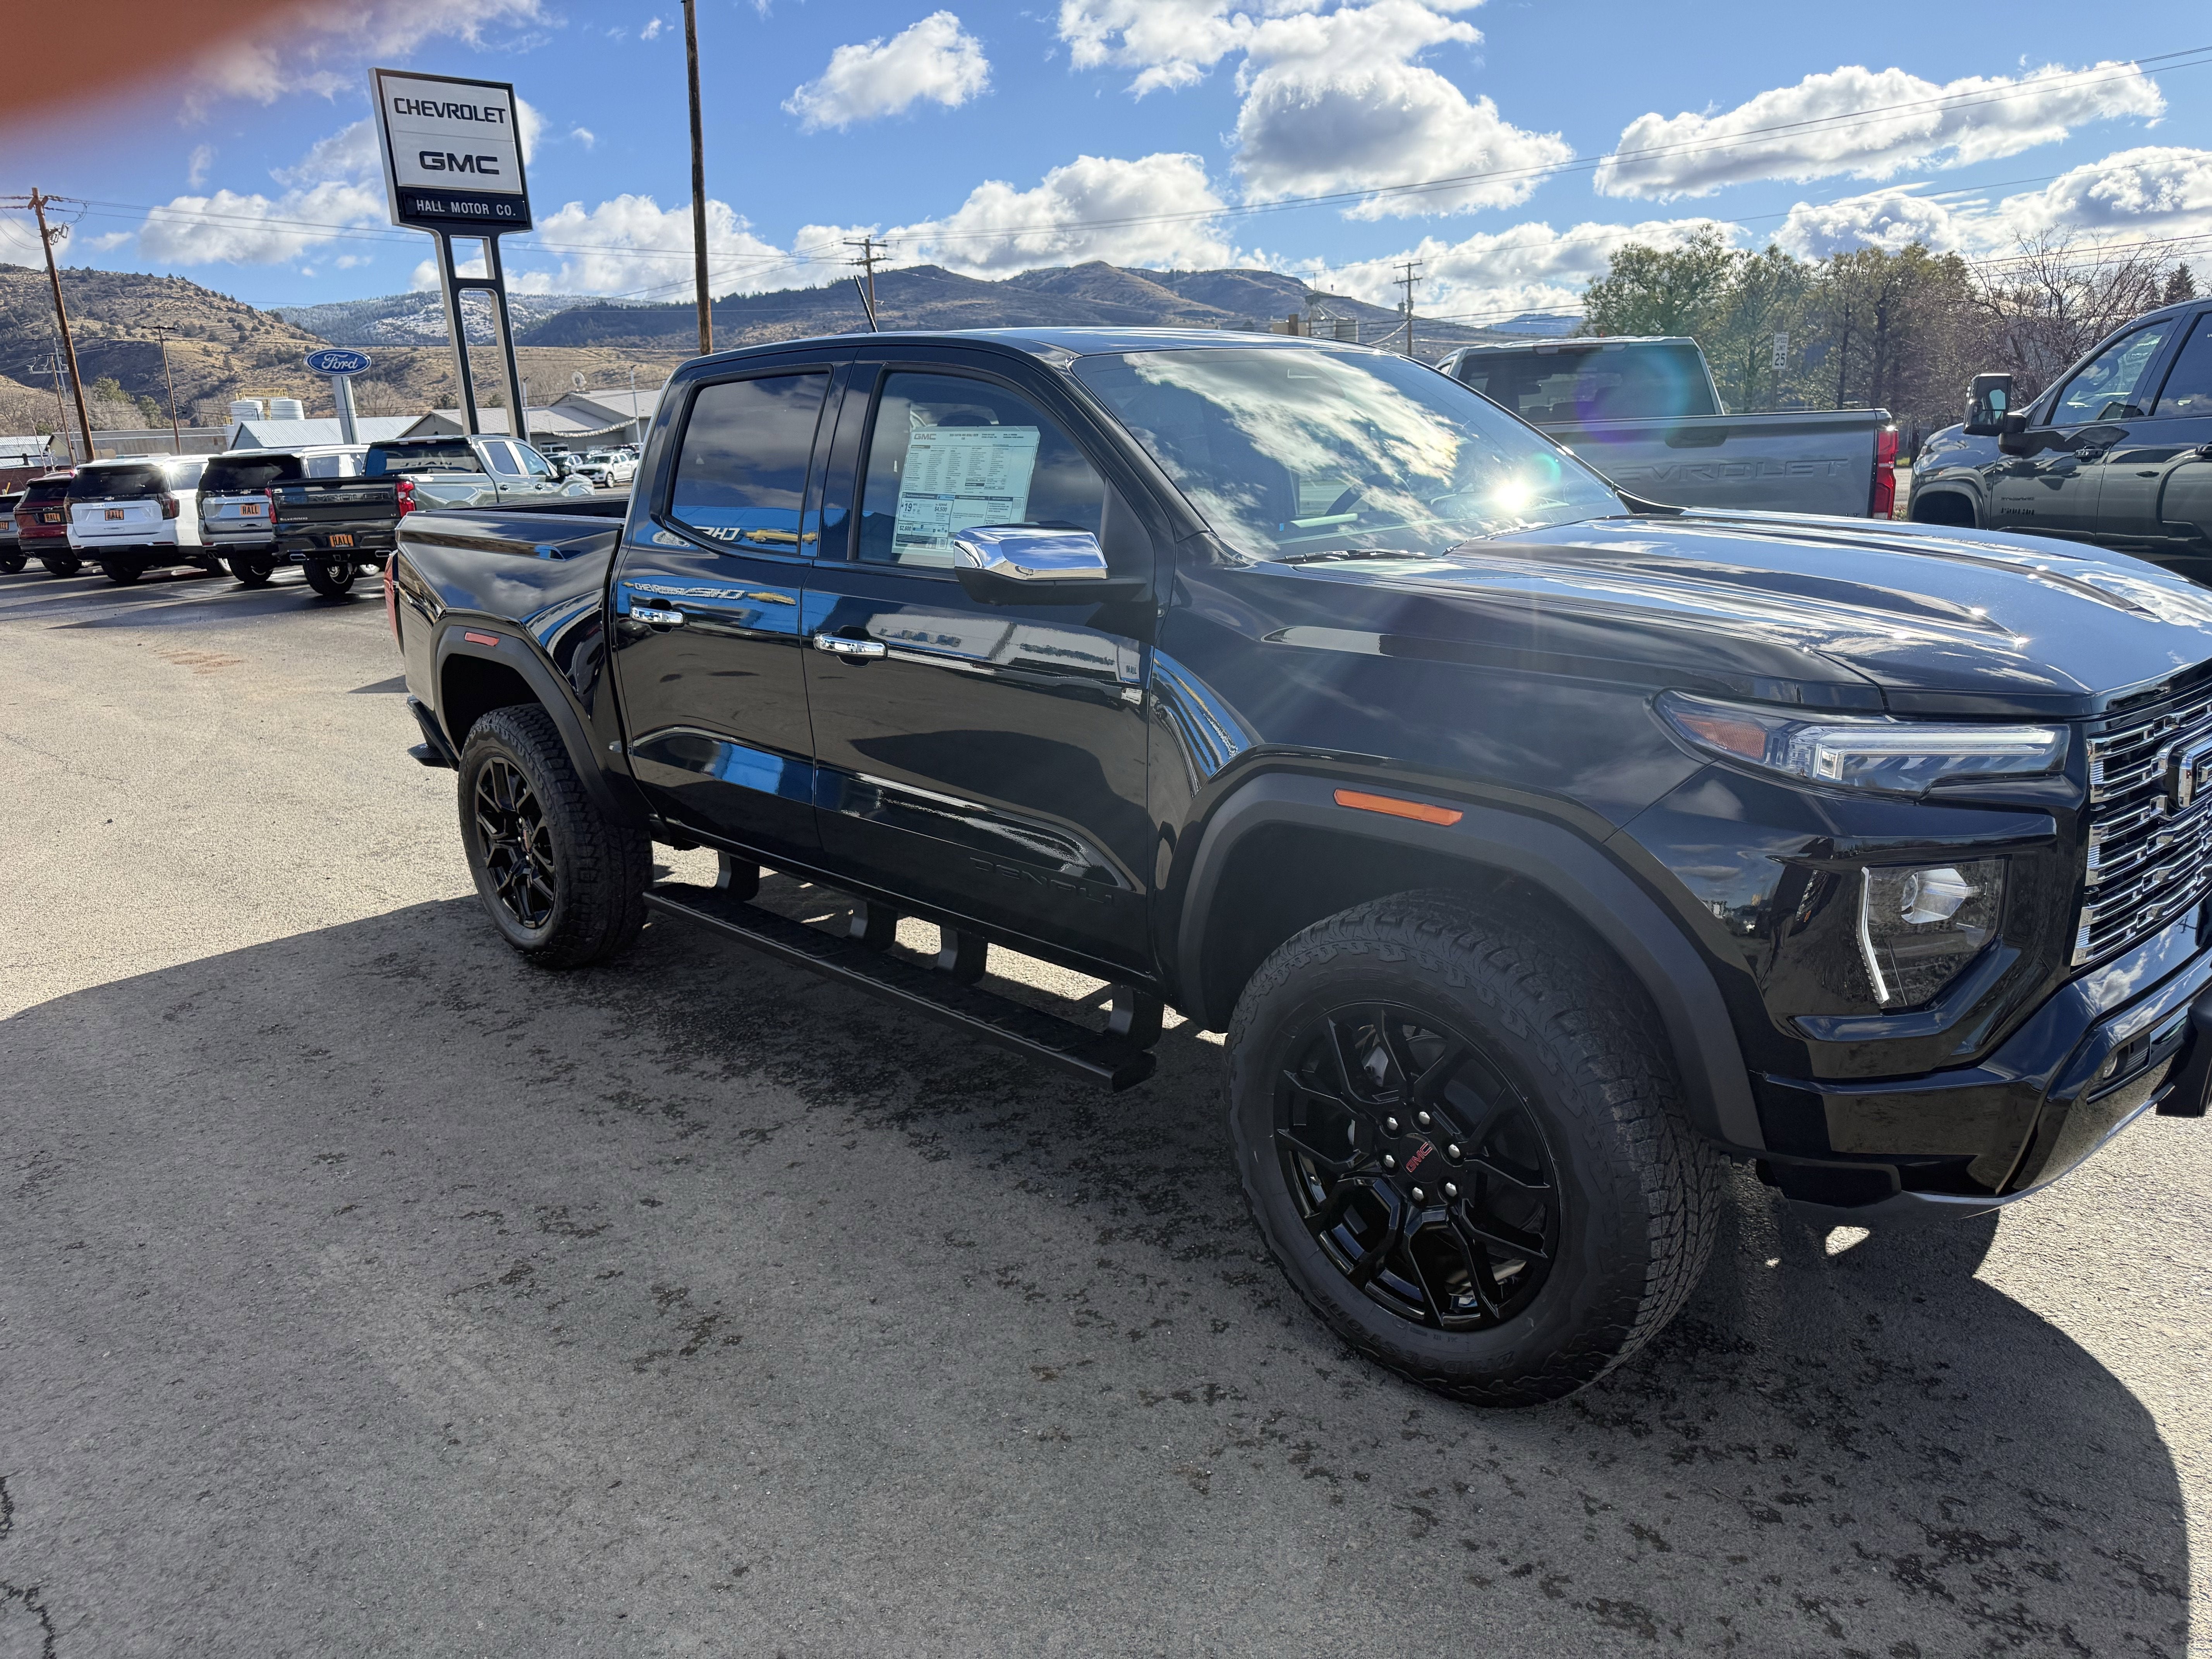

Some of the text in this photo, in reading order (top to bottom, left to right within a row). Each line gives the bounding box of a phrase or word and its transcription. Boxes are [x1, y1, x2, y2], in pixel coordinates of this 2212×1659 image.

[394, 98, 506, 124] CHEVROLET
[419, 151, 500, 175] GMC
[416, 199, 516, 216] HALL MOTOR CO.
[321, 354, 359, 369] Ford
[1775, 353, 1785, 366] 25
[1601, 459, 1848, 483] EVROLET
[107, 510, 122, 519] HALL
[242, 506, 259, 515] HALL
[905, 503, 912, 512] 19
[333, 535, 351, 545] HALL
[970, 857, 1113, 904] DENALI
[1406, 1142, 1433, 1173] GMC
